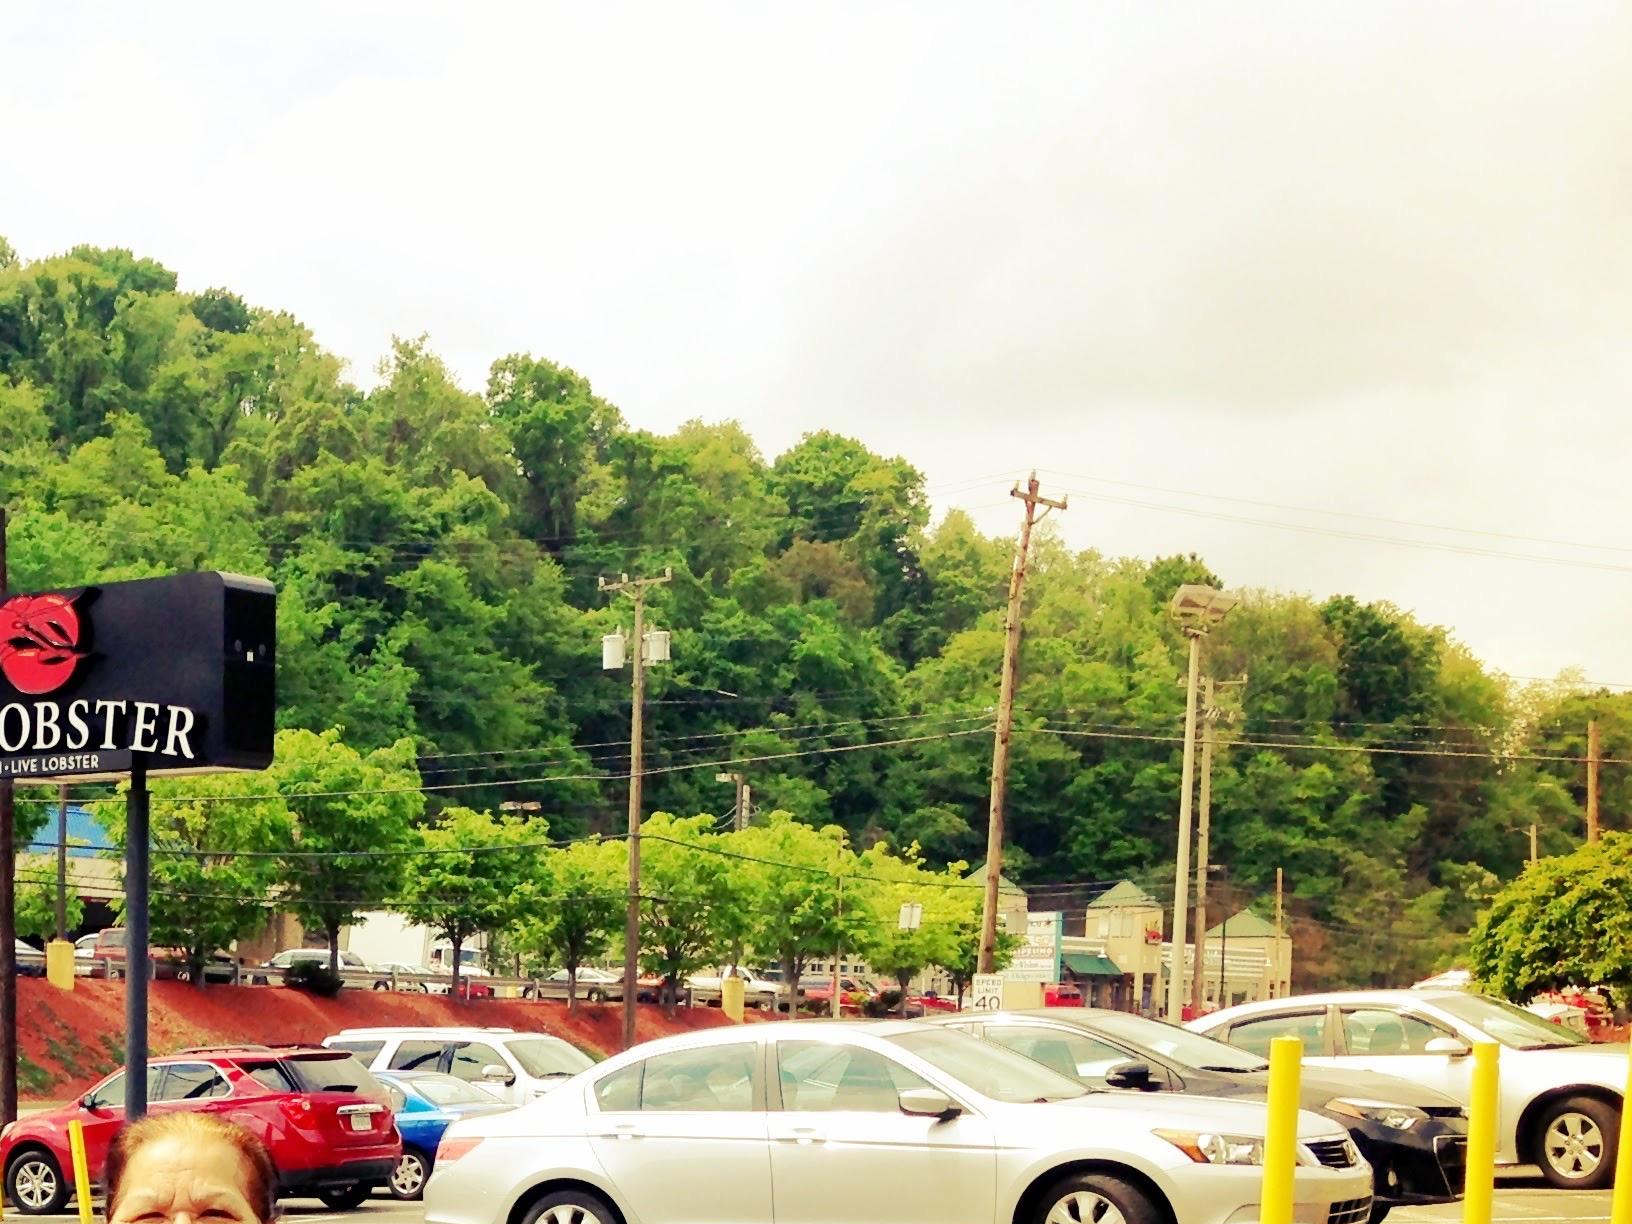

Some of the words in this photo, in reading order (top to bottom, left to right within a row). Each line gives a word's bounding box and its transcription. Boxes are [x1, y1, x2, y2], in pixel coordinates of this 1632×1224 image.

[11, 758, 38, 774] LIVE
[42, 754, 100, 772] LOBSTER
[975, 995, 1001, 1010] 40
